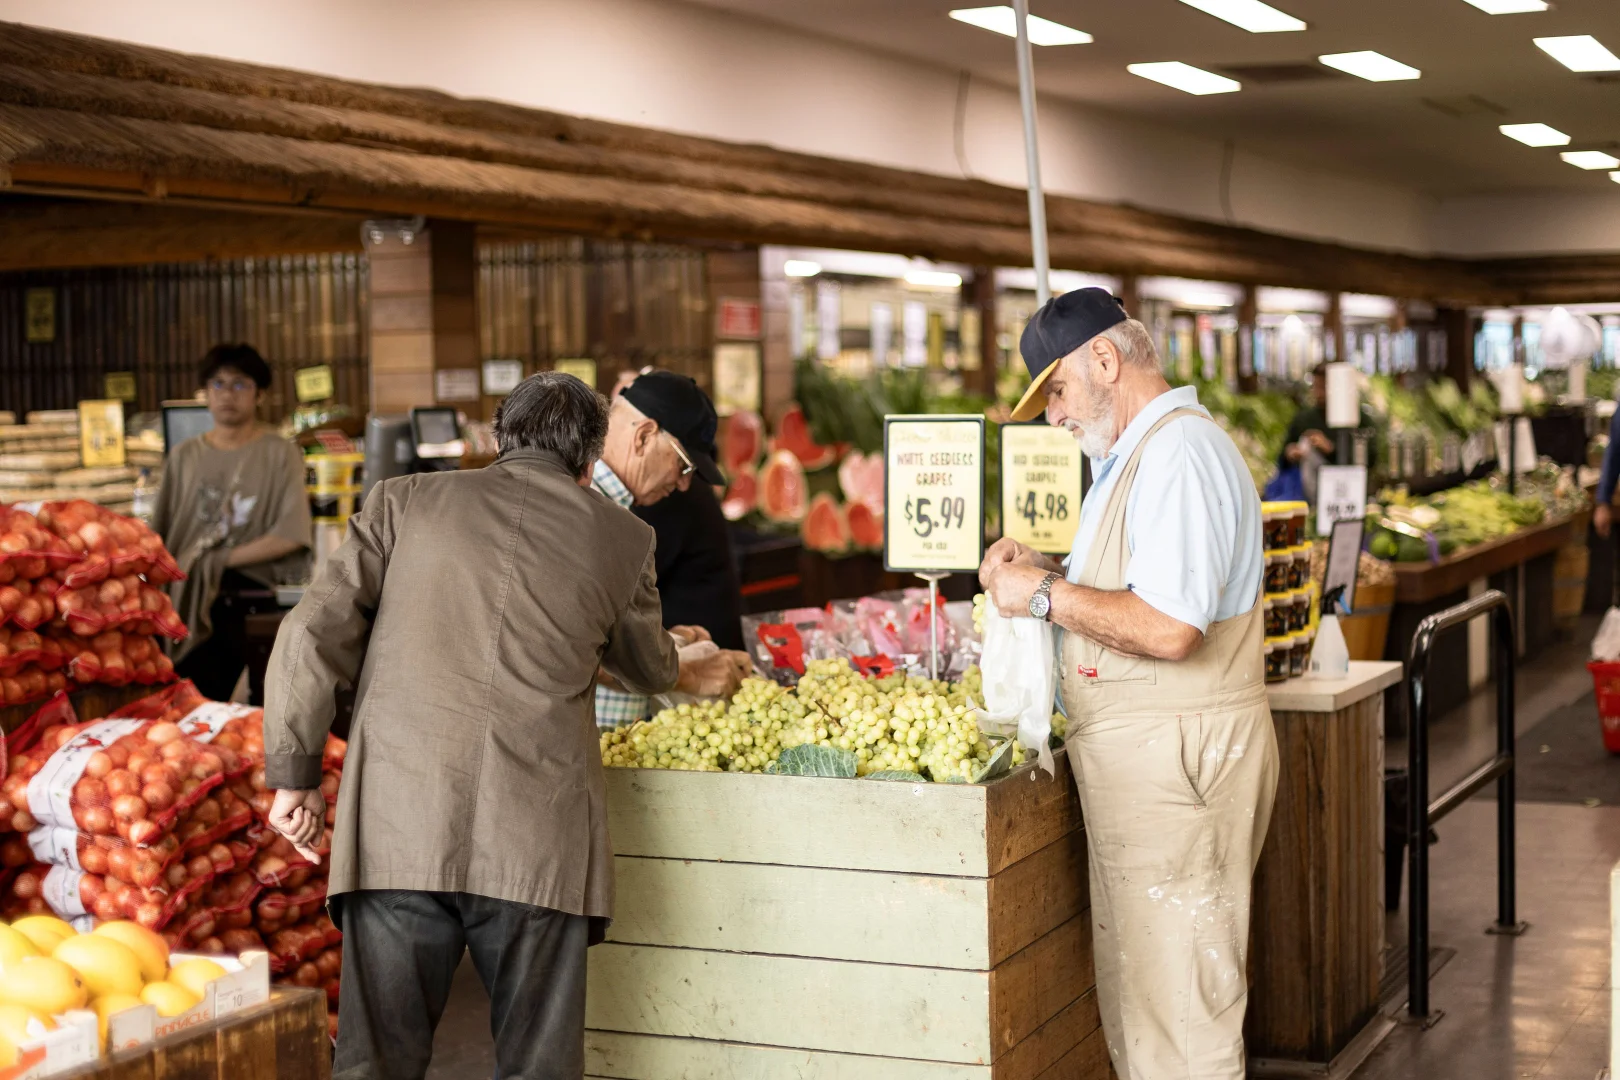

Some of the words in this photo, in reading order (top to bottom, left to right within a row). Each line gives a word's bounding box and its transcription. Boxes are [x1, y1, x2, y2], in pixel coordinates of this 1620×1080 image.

[897, 452, 924, 466] WHITE
[930, 452, 973, 466] SEEDLESS
[916, 472, 953, 486] GRAPES
[904, 494, 965, 538] $5.99
[1015, 491, 1068, 527] $4.98
[232, 994, 243, 1009] 10
[155, 1008, 209, 1036] PINNACLE
